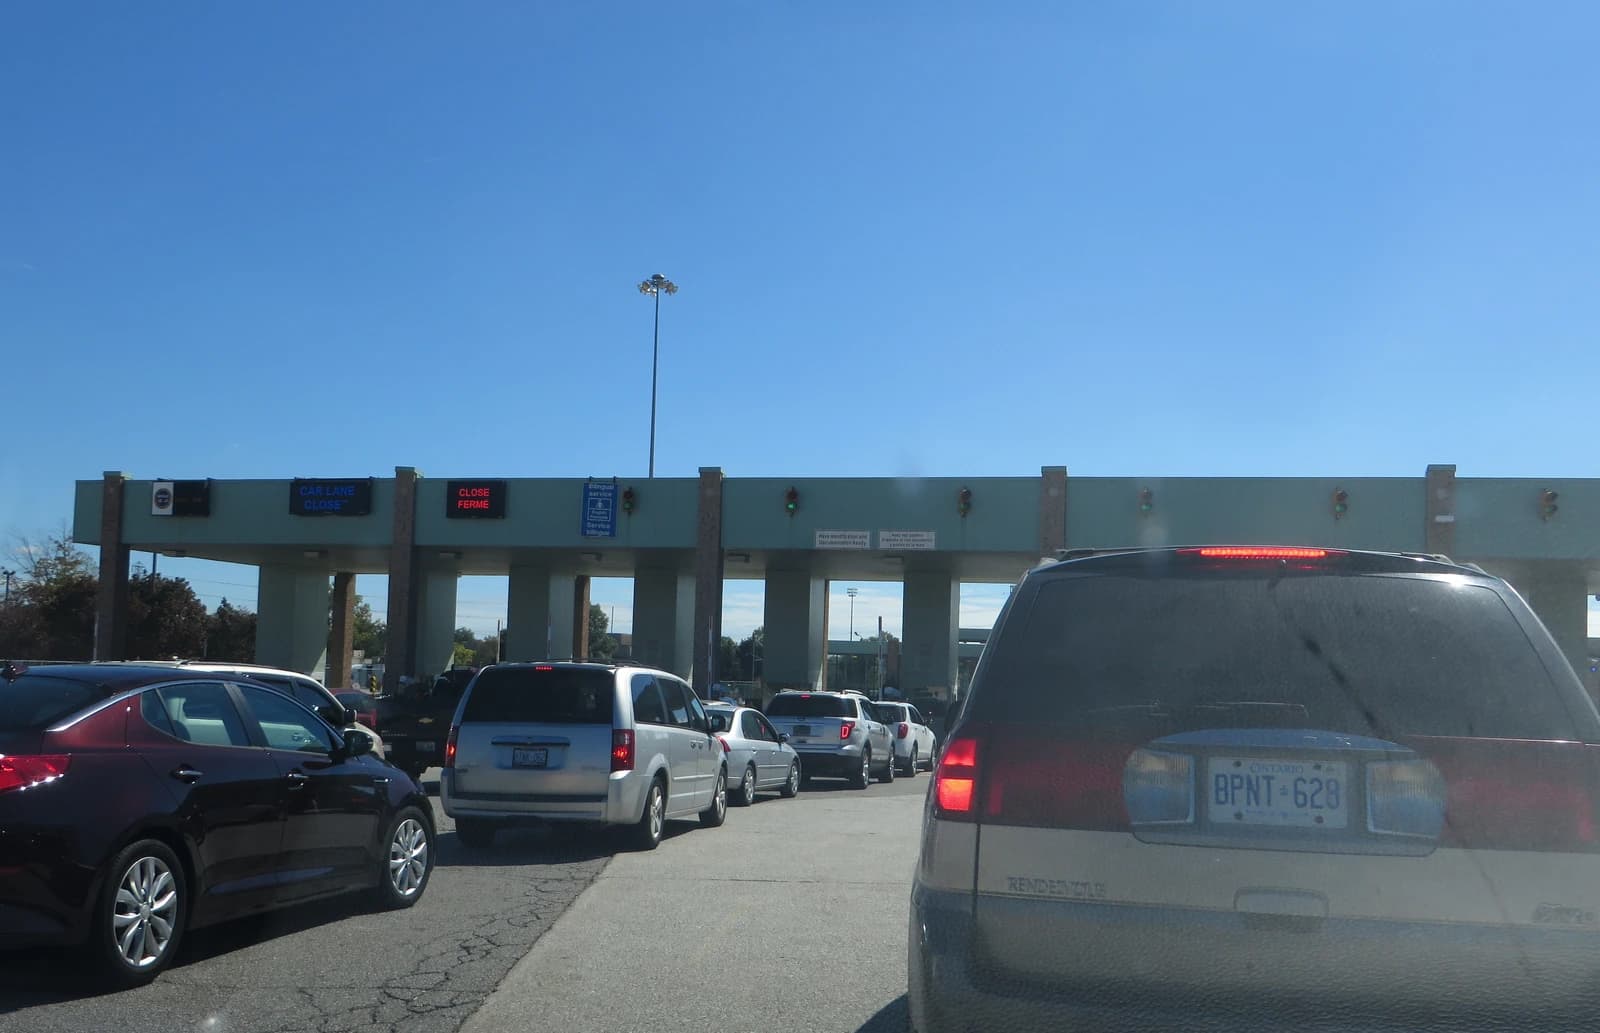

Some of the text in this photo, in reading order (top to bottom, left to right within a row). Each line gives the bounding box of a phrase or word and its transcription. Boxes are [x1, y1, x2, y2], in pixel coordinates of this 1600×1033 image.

[300, 485, 356, 496] CAR LANE
[459, 488, 490, 497] CLOSE
[1213, 774, 1275, 807] BPNT
